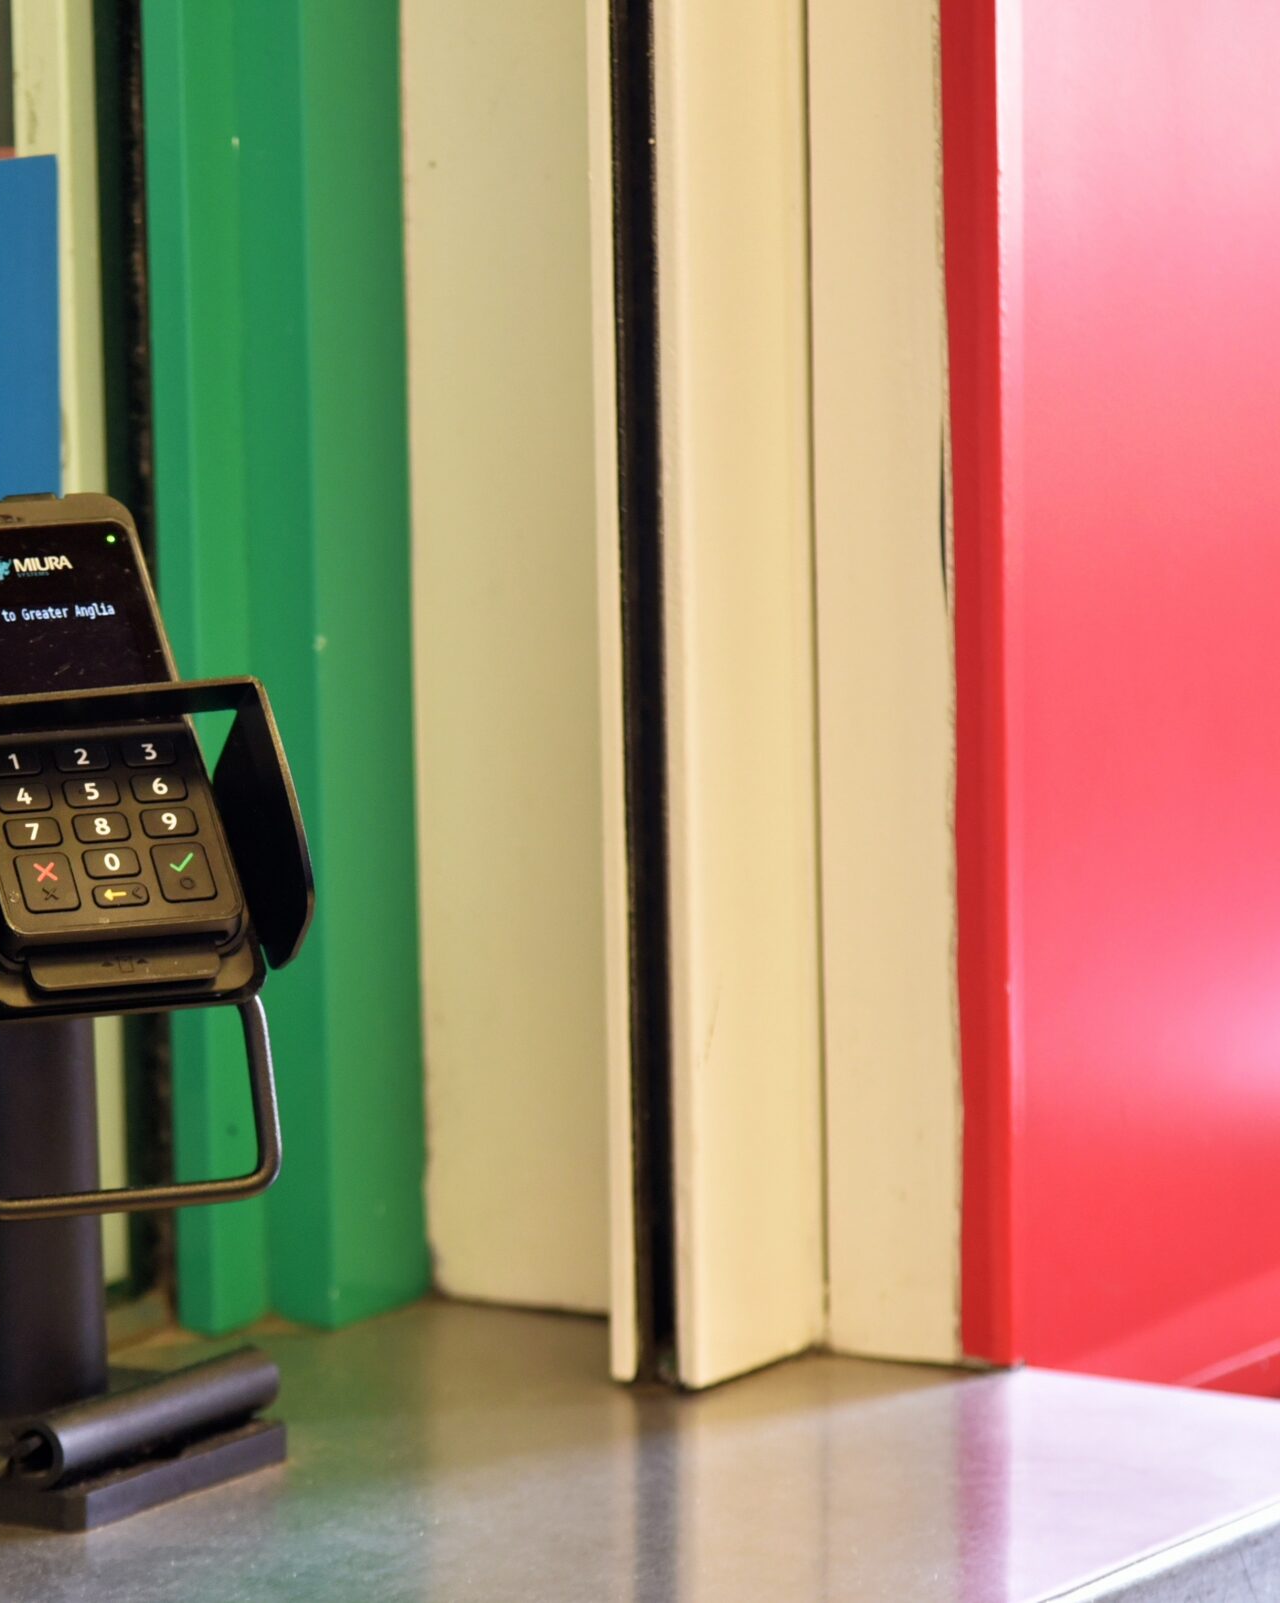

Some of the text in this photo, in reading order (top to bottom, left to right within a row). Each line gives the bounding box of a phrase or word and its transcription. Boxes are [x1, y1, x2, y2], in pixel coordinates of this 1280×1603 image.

[13, 555, 73, 573] MIURA
[1, 609, 17, 623] to
[21, 605, 69, 622] Greater
[75, 602, 116, 621] Anglia
[8, 743, 157, 770] 1 2 3
[16, 777, 168, 804] 4 5 6
[25, 812, 177, 840] 7 8 9
[103, 853, 120, 871] 0
